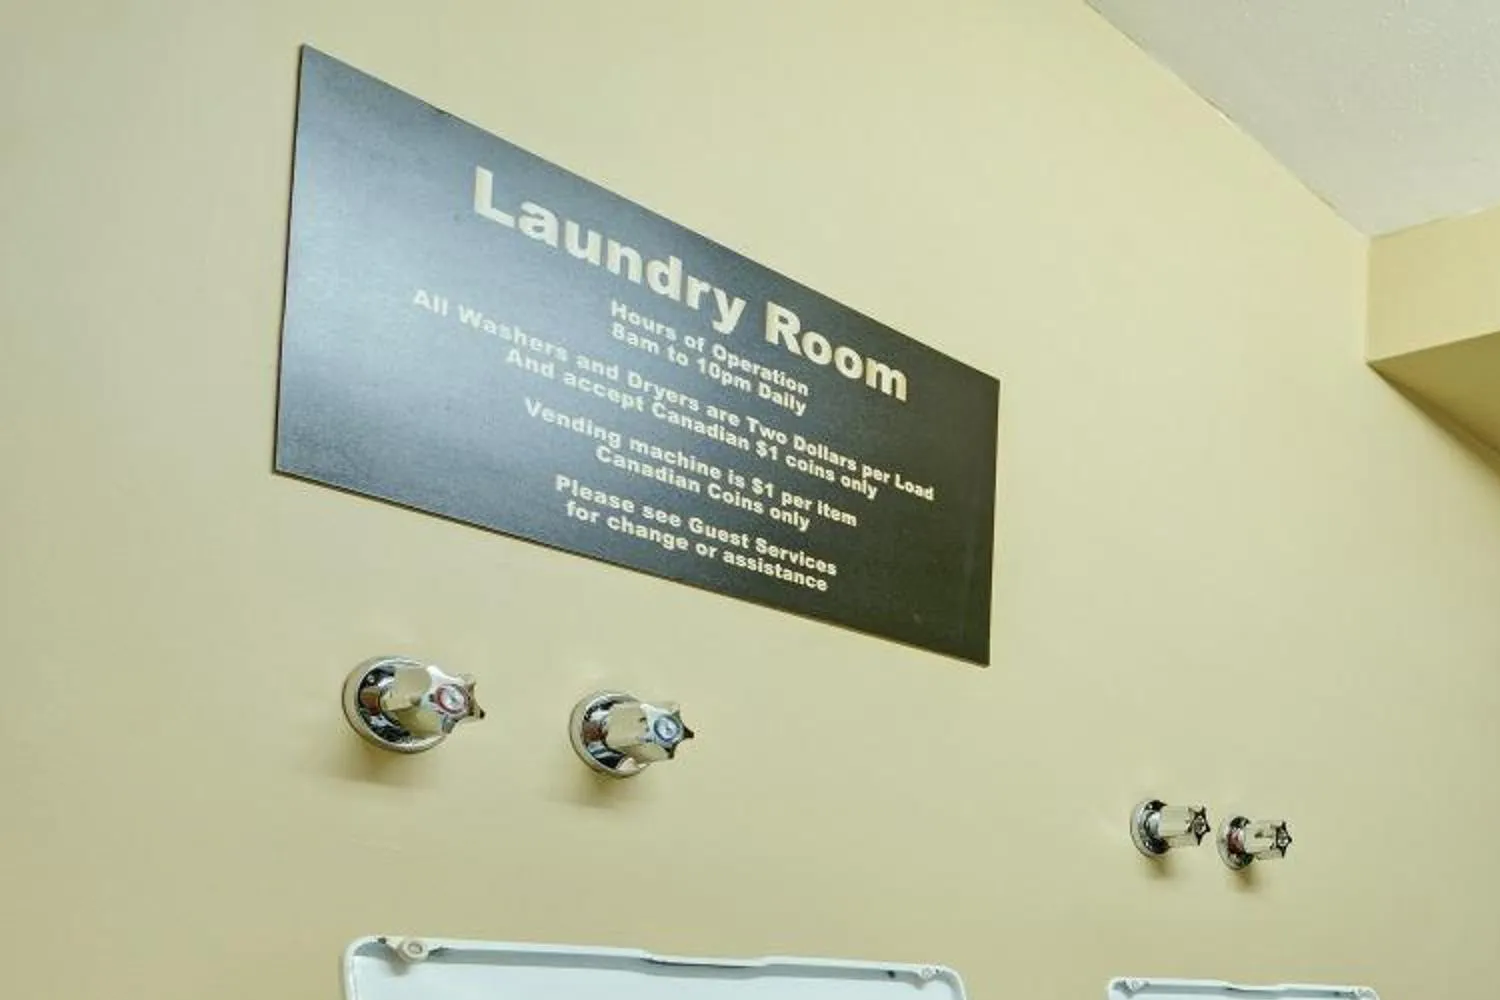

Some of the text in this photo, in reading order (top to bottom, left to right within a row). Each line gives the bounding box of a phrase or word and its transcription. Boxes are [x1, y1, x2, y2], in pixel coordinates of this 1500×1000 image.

[475, 166, 906, 401] Laundry Room
[413, 289, 448, 316] All
[576, 355, 619, 380] and
[628, 371, 699, 412] Dryers
[706, 405, 740, 427] are
[746, 416, 787, 444] Two
[793, 434, 856, 471] Dollars
[862, 464, 890, 483] per
[894, 473, 933, 500] Load
[611, 300, 808, 396] Hours of Operation
[612, 322, 806, 416] 8am to 10pm Daily
[506, 348, 877, 499] And accept Canadian $1 coins only
[525, 397, 621, 449] Vending
[630, 439, 721, 480] machine
[728, 469, 745, 488] is
[751, 477, 773, 498] $1
[781, 491, 812, 510] per
[556, 474, 836, 576] Please see Guest Services
[596, 445, 809, 532] Canadian Coins only
[566, 500, 828, 591] for change or assistance
